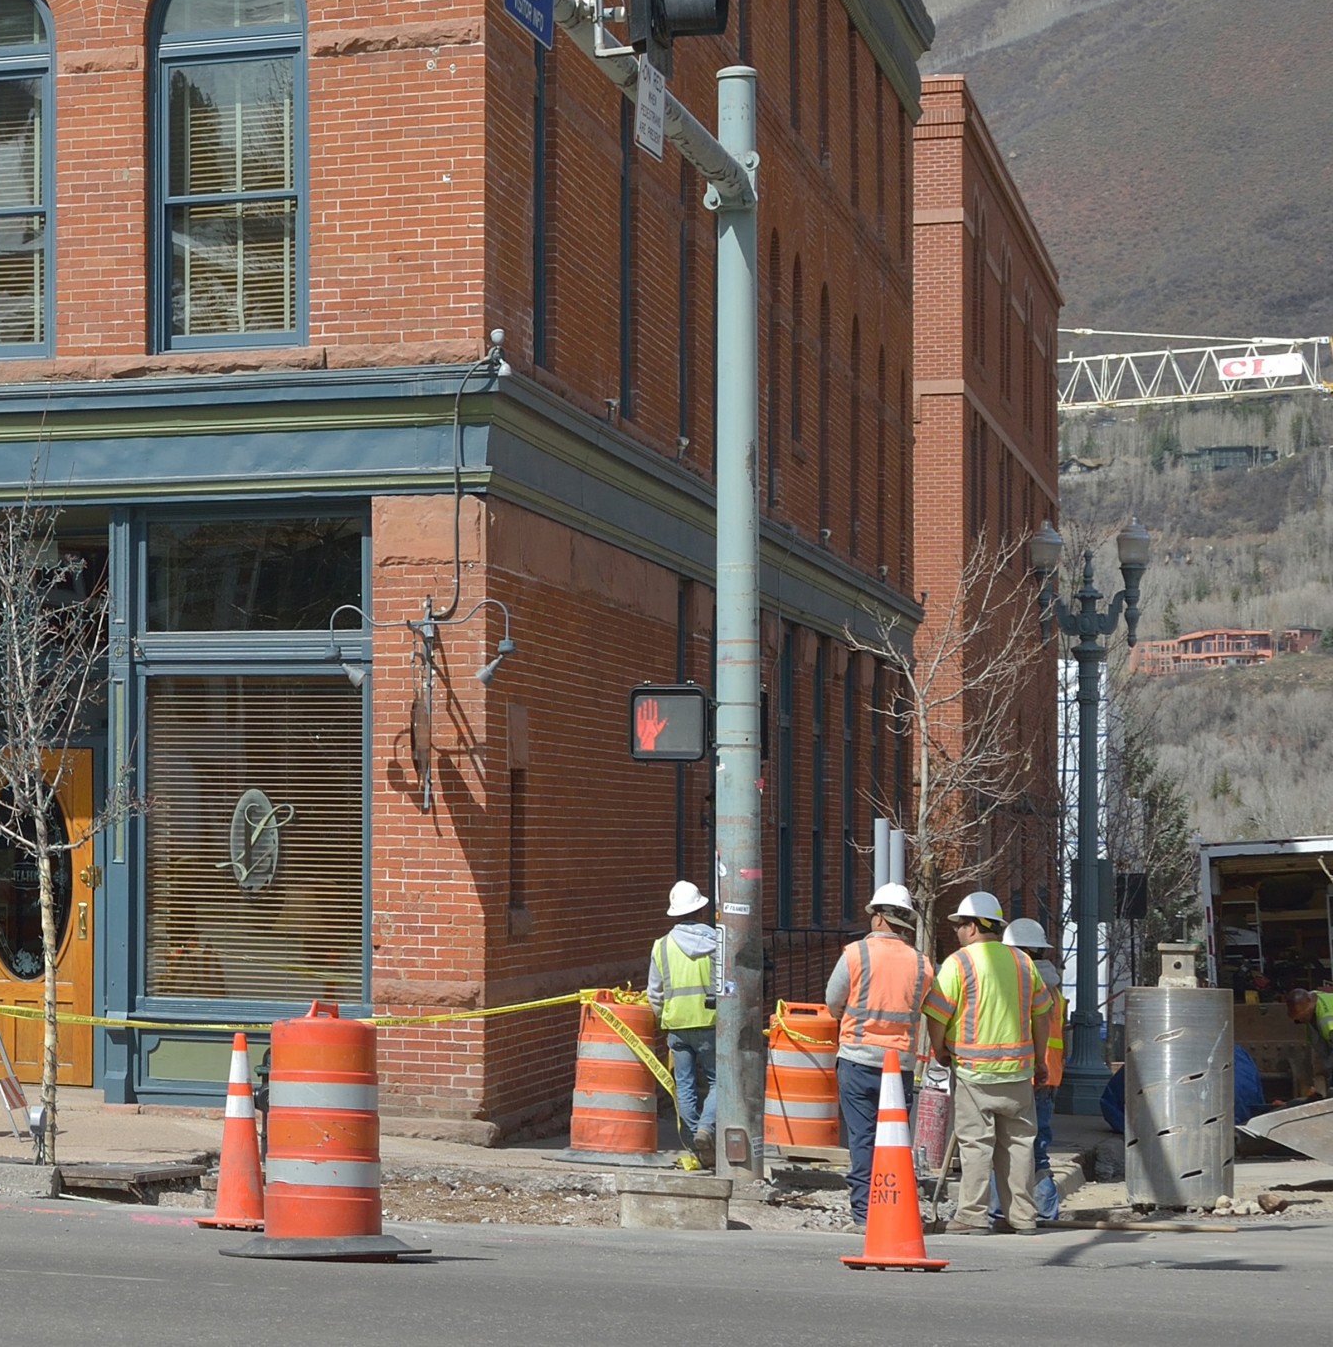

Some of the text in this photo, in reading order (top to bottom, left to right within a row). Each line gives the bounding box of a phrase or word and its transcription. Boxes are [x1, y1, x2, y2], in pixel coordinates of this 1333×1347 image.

[532, 5, 544, 33] INFO
[605, 1012, 614, 1022] NOT
[612, 1020, 621, 1029] DO
[619, 1027, 639, 1047] CAUTION
